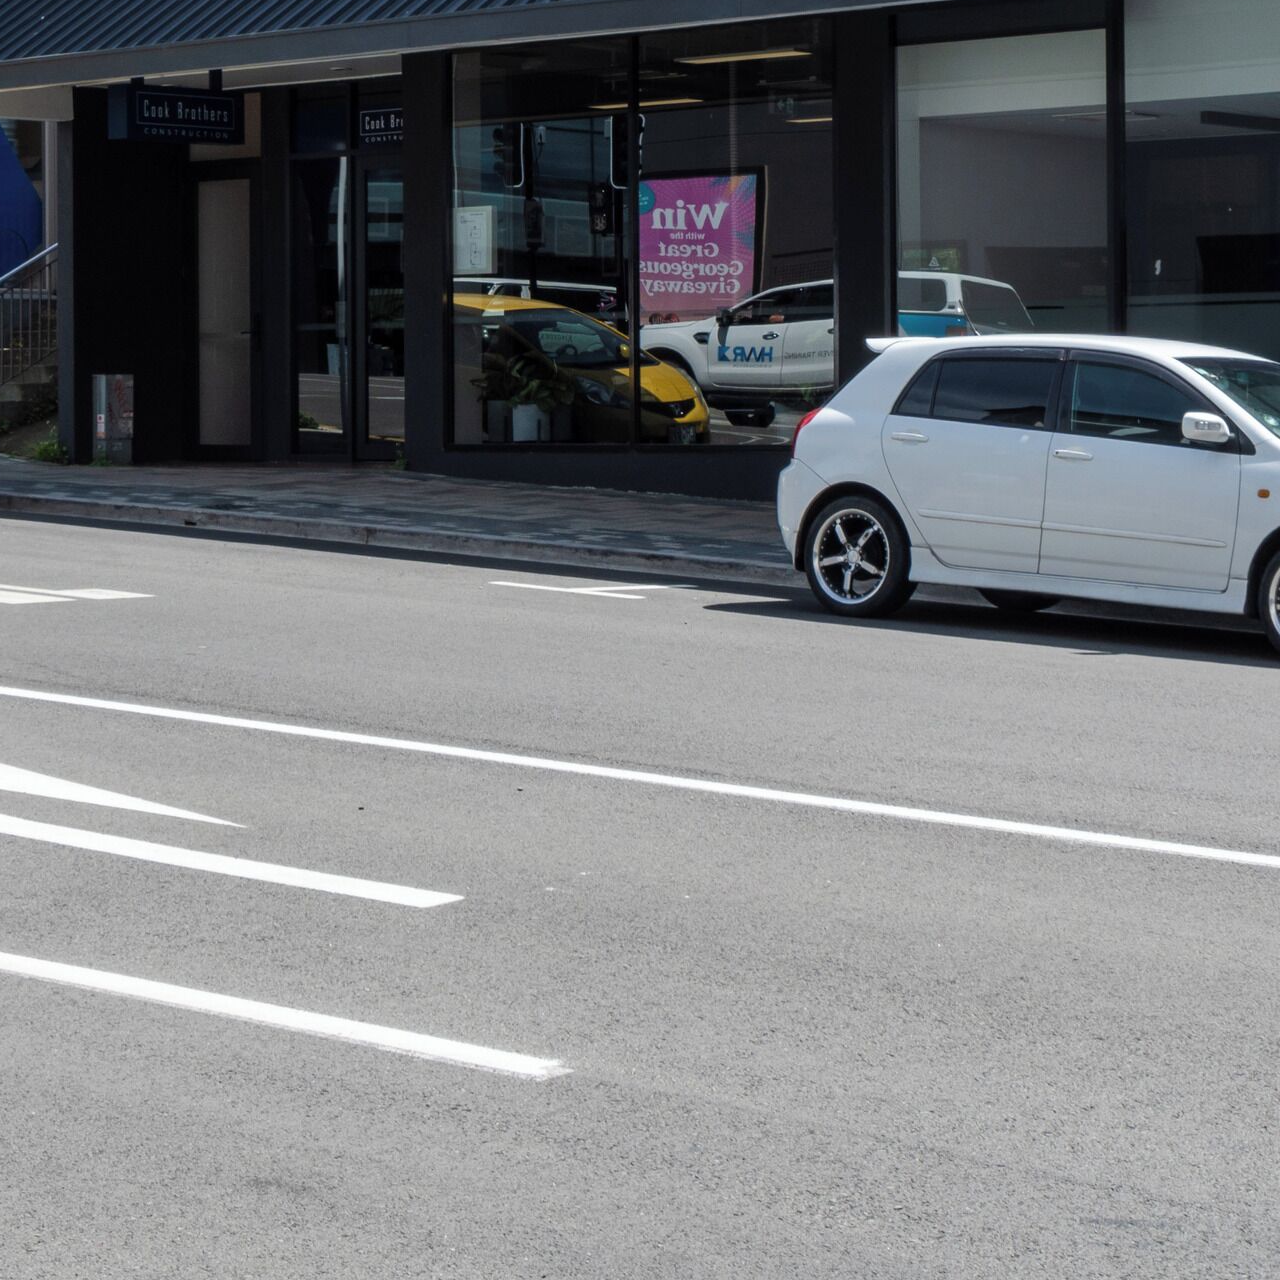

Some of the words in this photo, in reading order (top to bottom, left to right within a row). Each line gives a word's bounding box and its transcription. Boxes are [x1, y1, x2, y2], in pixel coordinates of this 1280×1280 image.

[144, 99, 170, 119] Cook
[177, 101, 229, 123] Brothers
[365, 115, 385, 131] Cook
[143, 127, 229, 140] CONSTRUCTION
